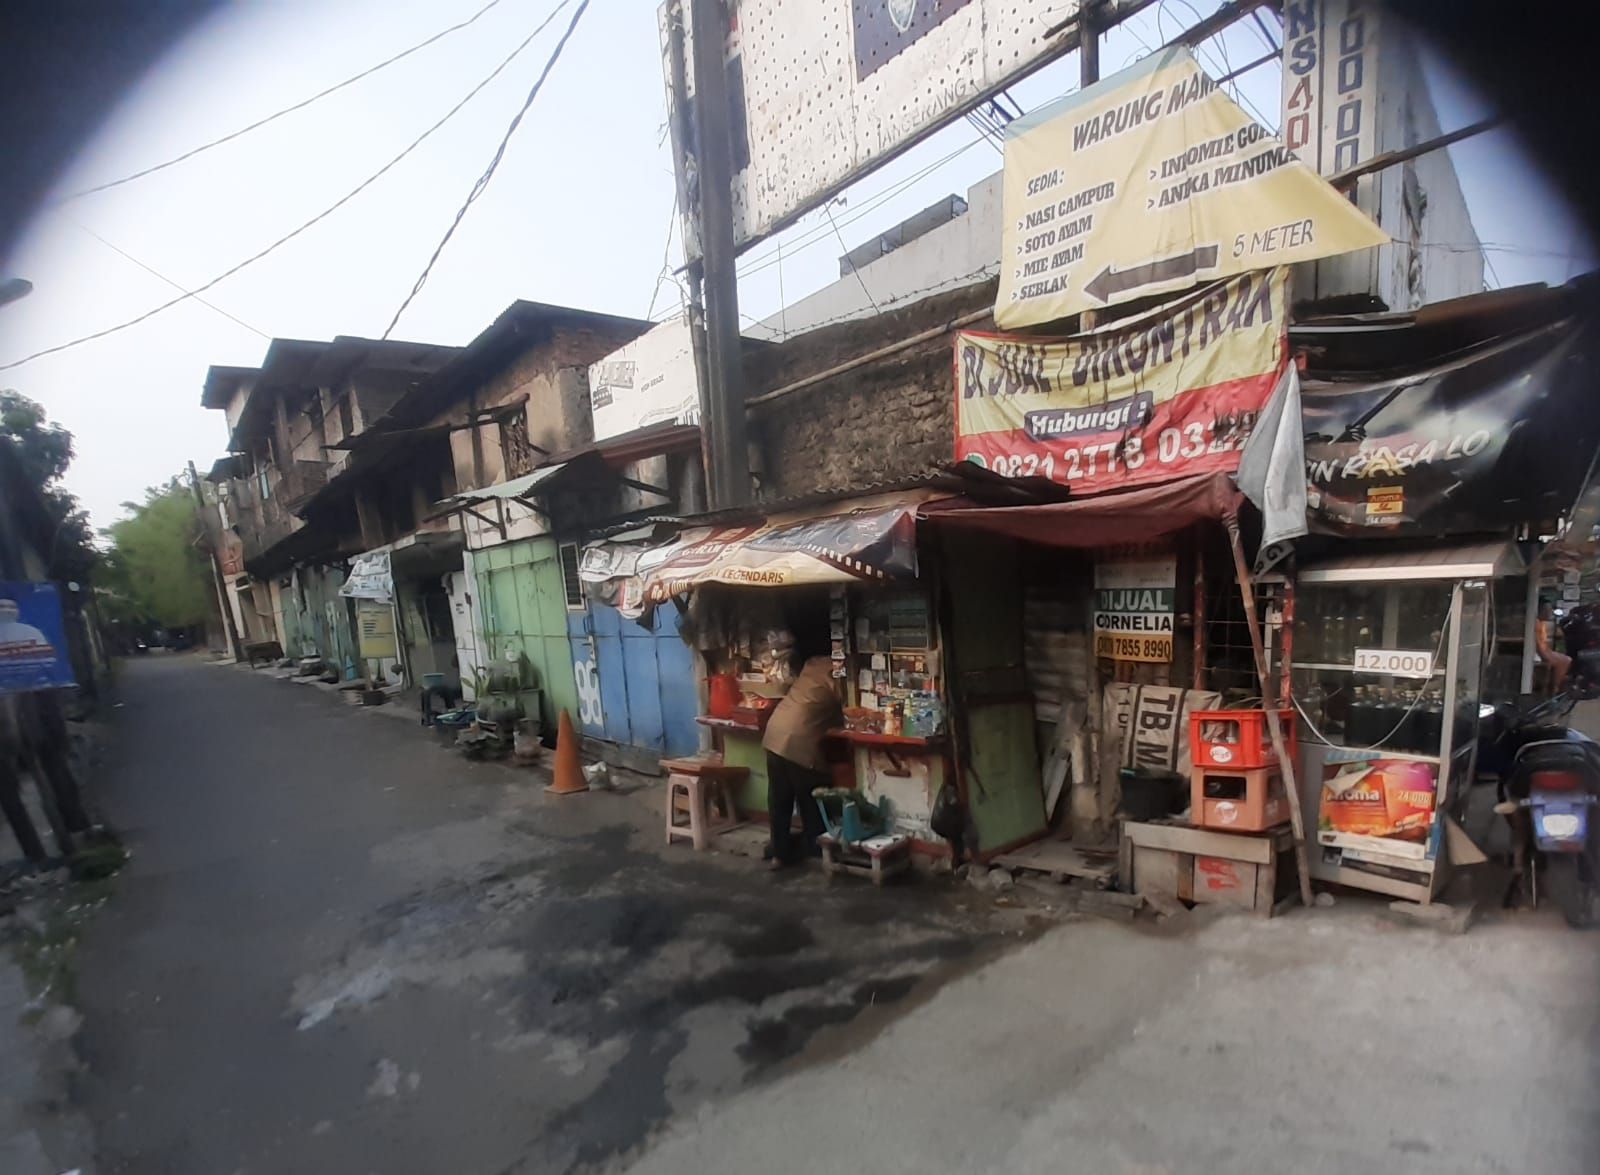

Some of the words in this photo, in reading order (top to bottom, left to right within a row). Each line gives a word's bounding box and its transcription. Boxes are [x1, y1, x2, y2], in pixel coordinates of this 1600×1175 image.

[1073, 90, 1164, 152] WARUNG
[1025, 204, 1056, 230] NASI
[1058, 181, 1115, 217] CAMPUR
[1025, 230, 1056, 255] SOTO
[1058, 214, 1093, 242] AYAM
[1233, 234, 1245, 257] 5
[1250, 219, 1314, 254] METER
[1023, 257, 1049, 278] MIE
[1051, 243, 1084, 269] AYAM
[1020, 274, 1069, 300] SEBLAK
[964, 345, 985, 399] DI
[1031, 402, 1129, 436] Hubungi
[722, 569, 784, 584] LEGENDARIS
[1101, 590, 1169, 611] DIJUAL
[1096, 614, 1172, 632] CORNELIA
[1115, 638, 1141, 657] 7855
[1143, 639, 1171, 658] 8990
[1357, 653, 1428, 672] 12.000
[1136, 740, 1169, 768] M
